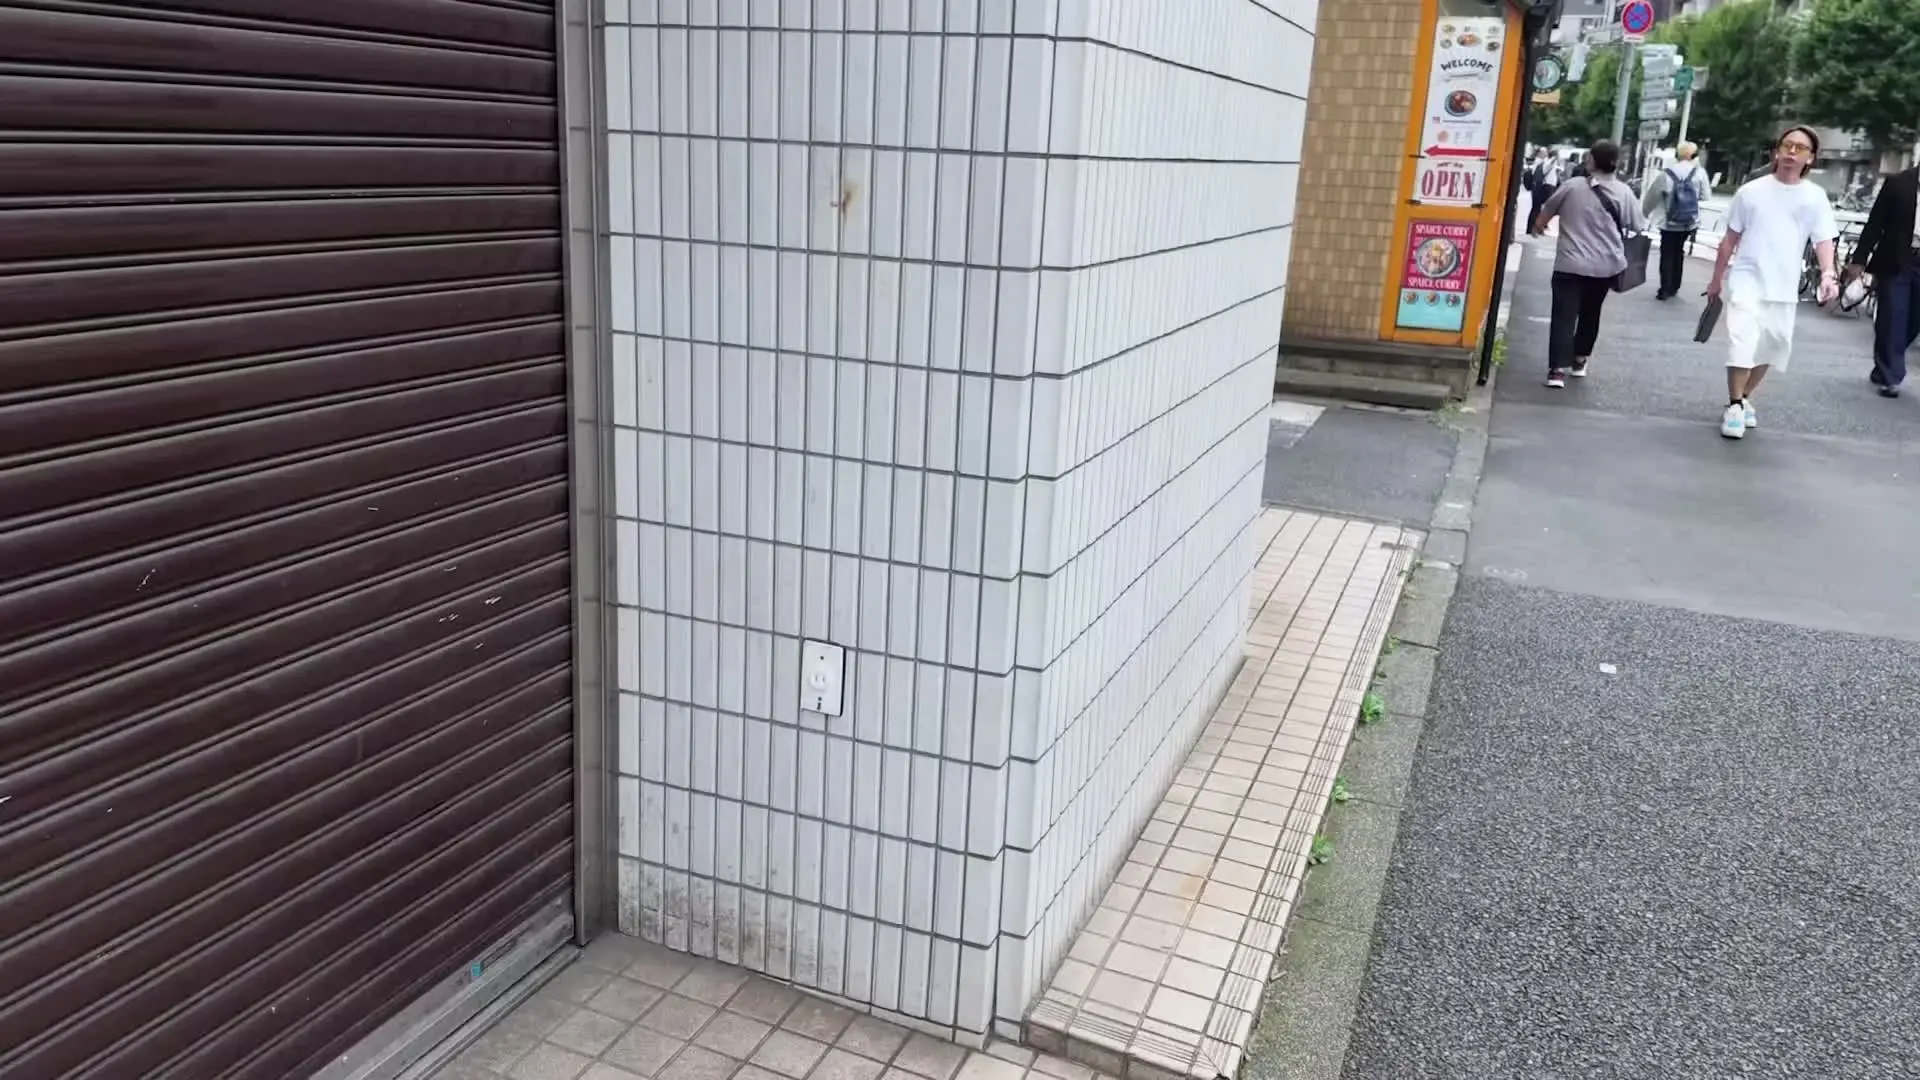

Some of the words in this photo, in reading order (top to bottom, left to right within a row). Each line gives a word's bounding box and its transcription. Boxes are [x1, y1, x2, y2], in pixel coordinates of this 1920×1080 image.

[1440, 58, 1494, 73] WELCOME
[1421, 169, 1476, 198] OPEN
[1443, 226, 1469, 236] CURRY
[1435, 279, 1460, 289] CURRY
